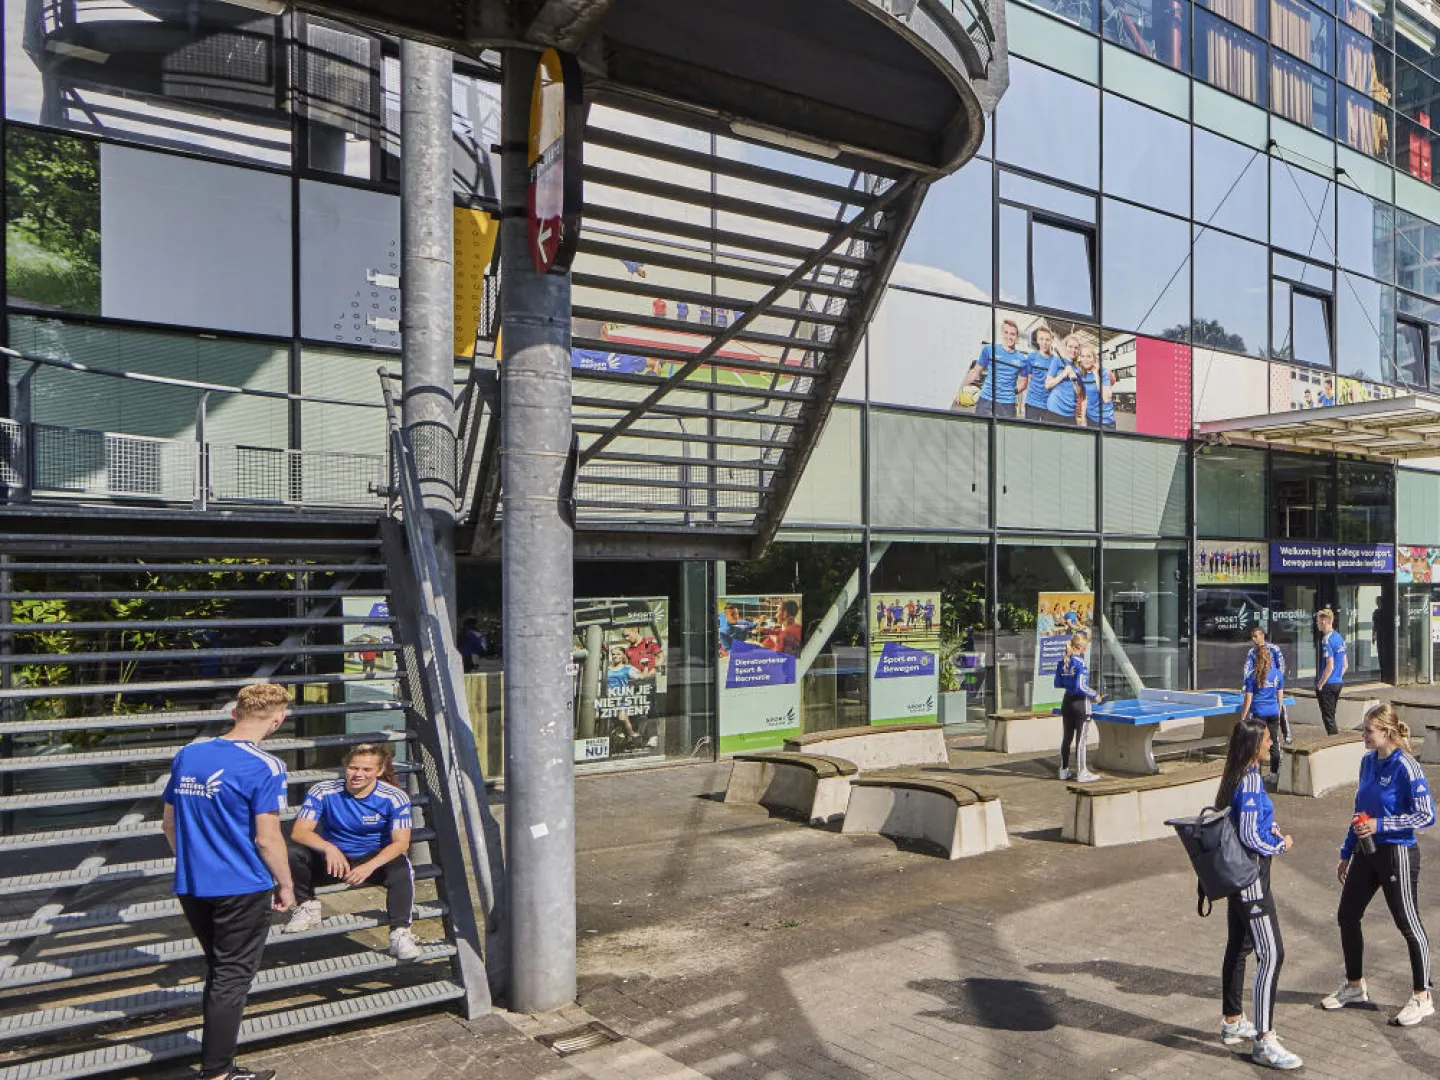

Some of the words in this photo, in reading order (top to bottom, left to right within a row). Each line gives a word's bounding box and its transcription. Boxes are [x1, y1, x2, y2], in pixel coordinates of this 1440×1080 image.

[1280, 546, 1311, 555] Welkom
[1312, 547, 1321, 557] bij
[1337, 547, 1360, 558] College
[1360, 549, 1374, 557] voor
[1282, 558, 1313, 568] bewegen
[1337, 559, 1363, 569] gezonde
[1214, 615, 1238, 623] SPORT
[883, 656, 905, 664] Sport
[883, 665, 920, 673] Bewegen
[735, 674, 771, 682] Recreatie
[608, 686, 634, 697] KUN
[635, 684, 650, 695] JE
[594, 697, 623, 708] NIET
[624, 695, 651, 706] STIL
[600, 706, 651, 718] ZITTEN?
[585, 746, 608, 757] NU!
